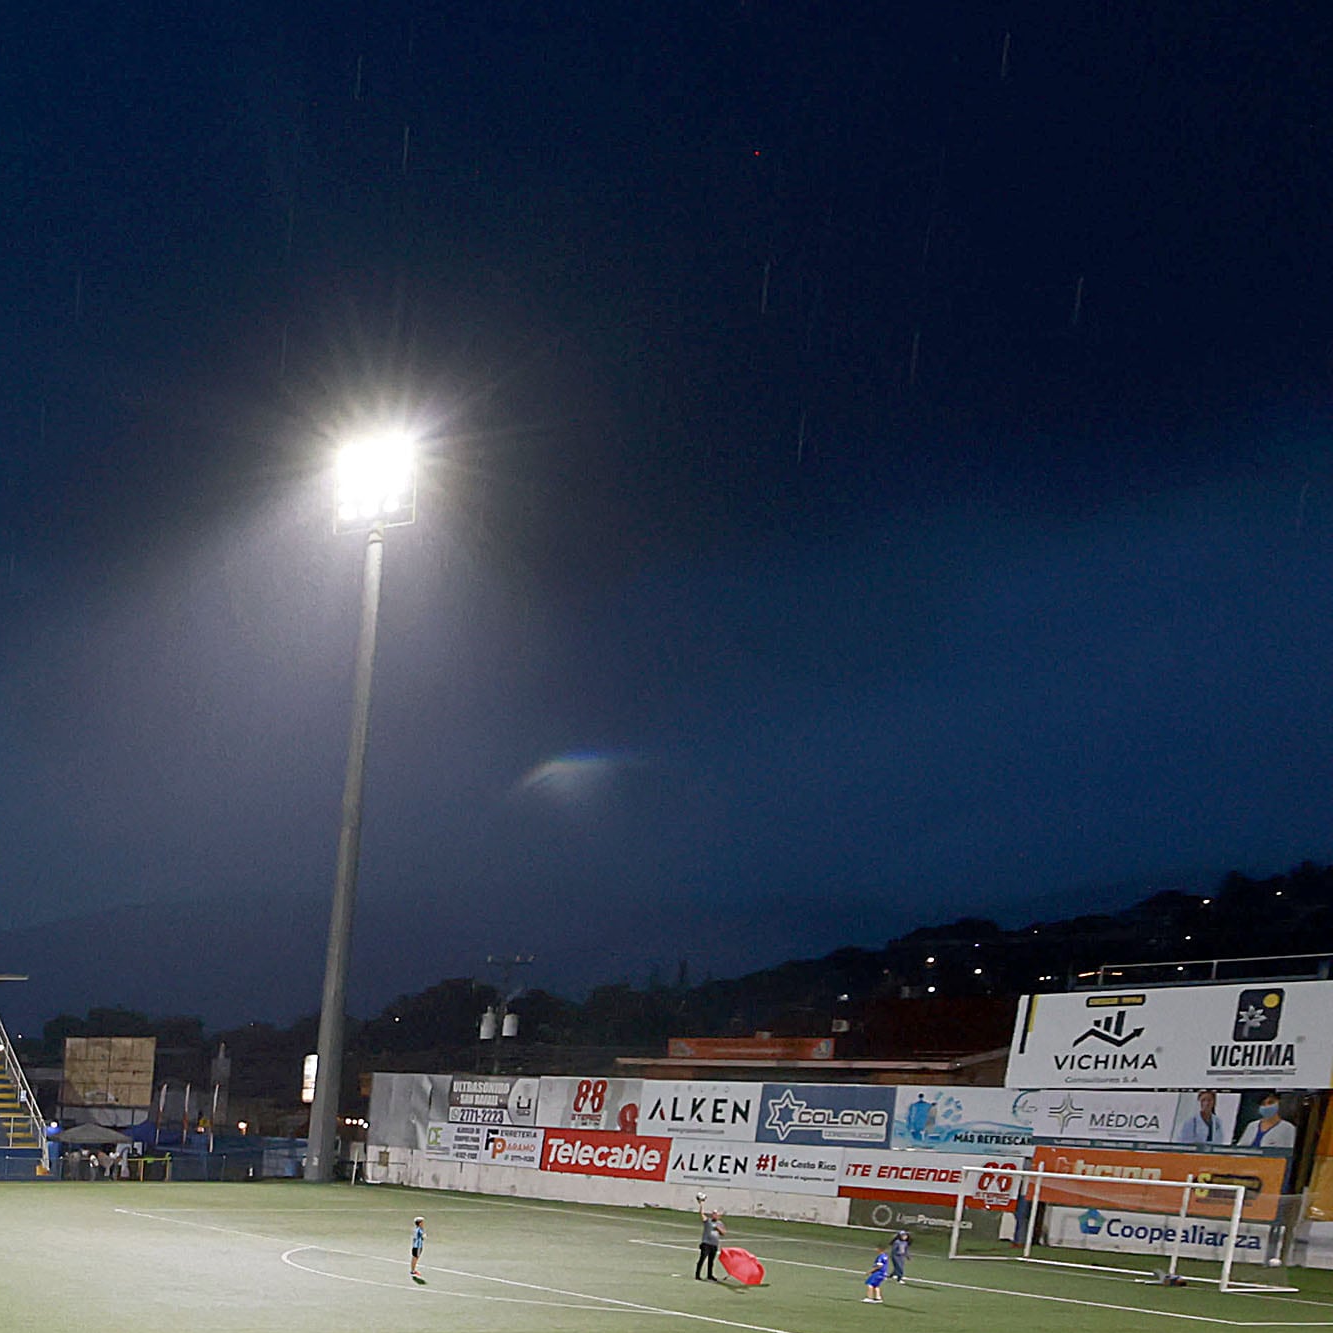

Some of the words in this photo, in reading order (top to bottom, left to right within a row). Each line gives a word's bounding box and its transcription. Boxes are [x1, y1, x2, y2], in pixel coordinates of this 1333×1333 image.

[1054, 1053, 1158, 1070] VICHIMA
[1210, 1044, 1295, 1067] VICHIMA
[573, 1079, 607, 1113] 88
[647, 1096, 752, 1124] ALKEN
[798, 1110, 885, 1127] COLONO
[1089, 1110, 1160, 1129] MÉDICA
[547, 1138, 662, 1172] Telecable
[671, 1153, 749, 1175] ALKEN
[756, 1154, 777, 1172] #1
[778, 1160, 789, 1168] de
[791, 1159, 816, 1170] Costa
[818, 1161, 837, 1171] Rica
[877, 1165, 963, 1184] ENCIENDE
